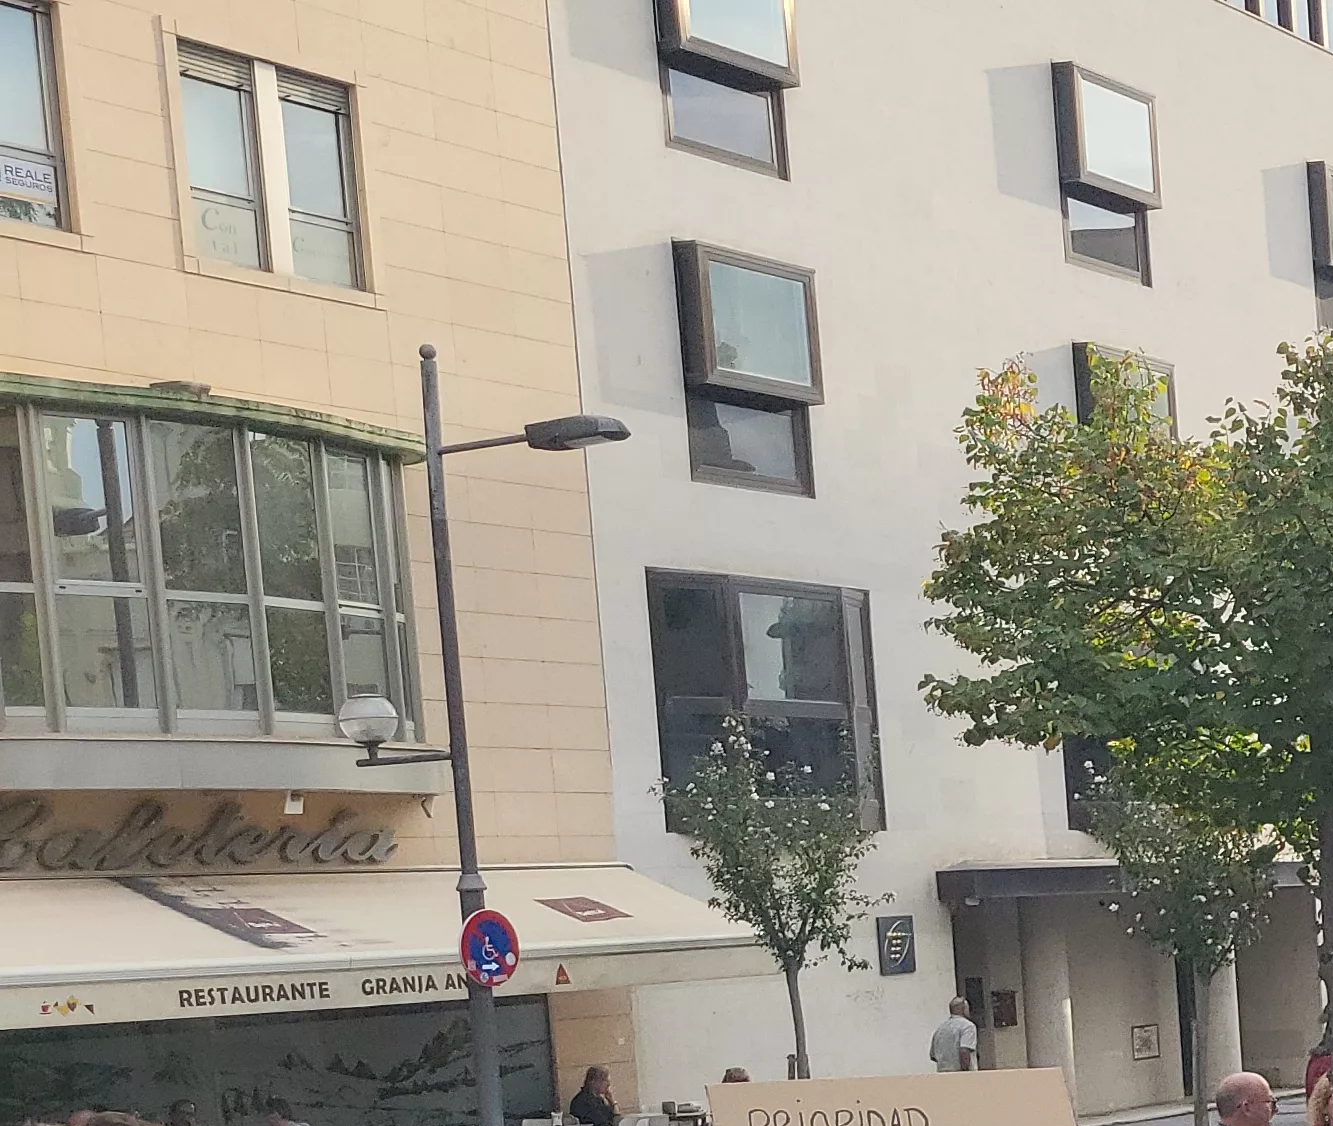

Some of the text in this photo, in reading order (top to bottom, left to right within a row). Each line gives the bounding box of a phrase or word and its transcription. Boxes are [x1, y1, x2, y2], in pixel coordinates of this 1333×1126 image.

[4, 164, 53, 185] REALE
[5, 176, 53, 193] SEGUROS
[178, 981, 331, 1008] RESTAURANTE
[361, 974, 438, 996] GRANJA
